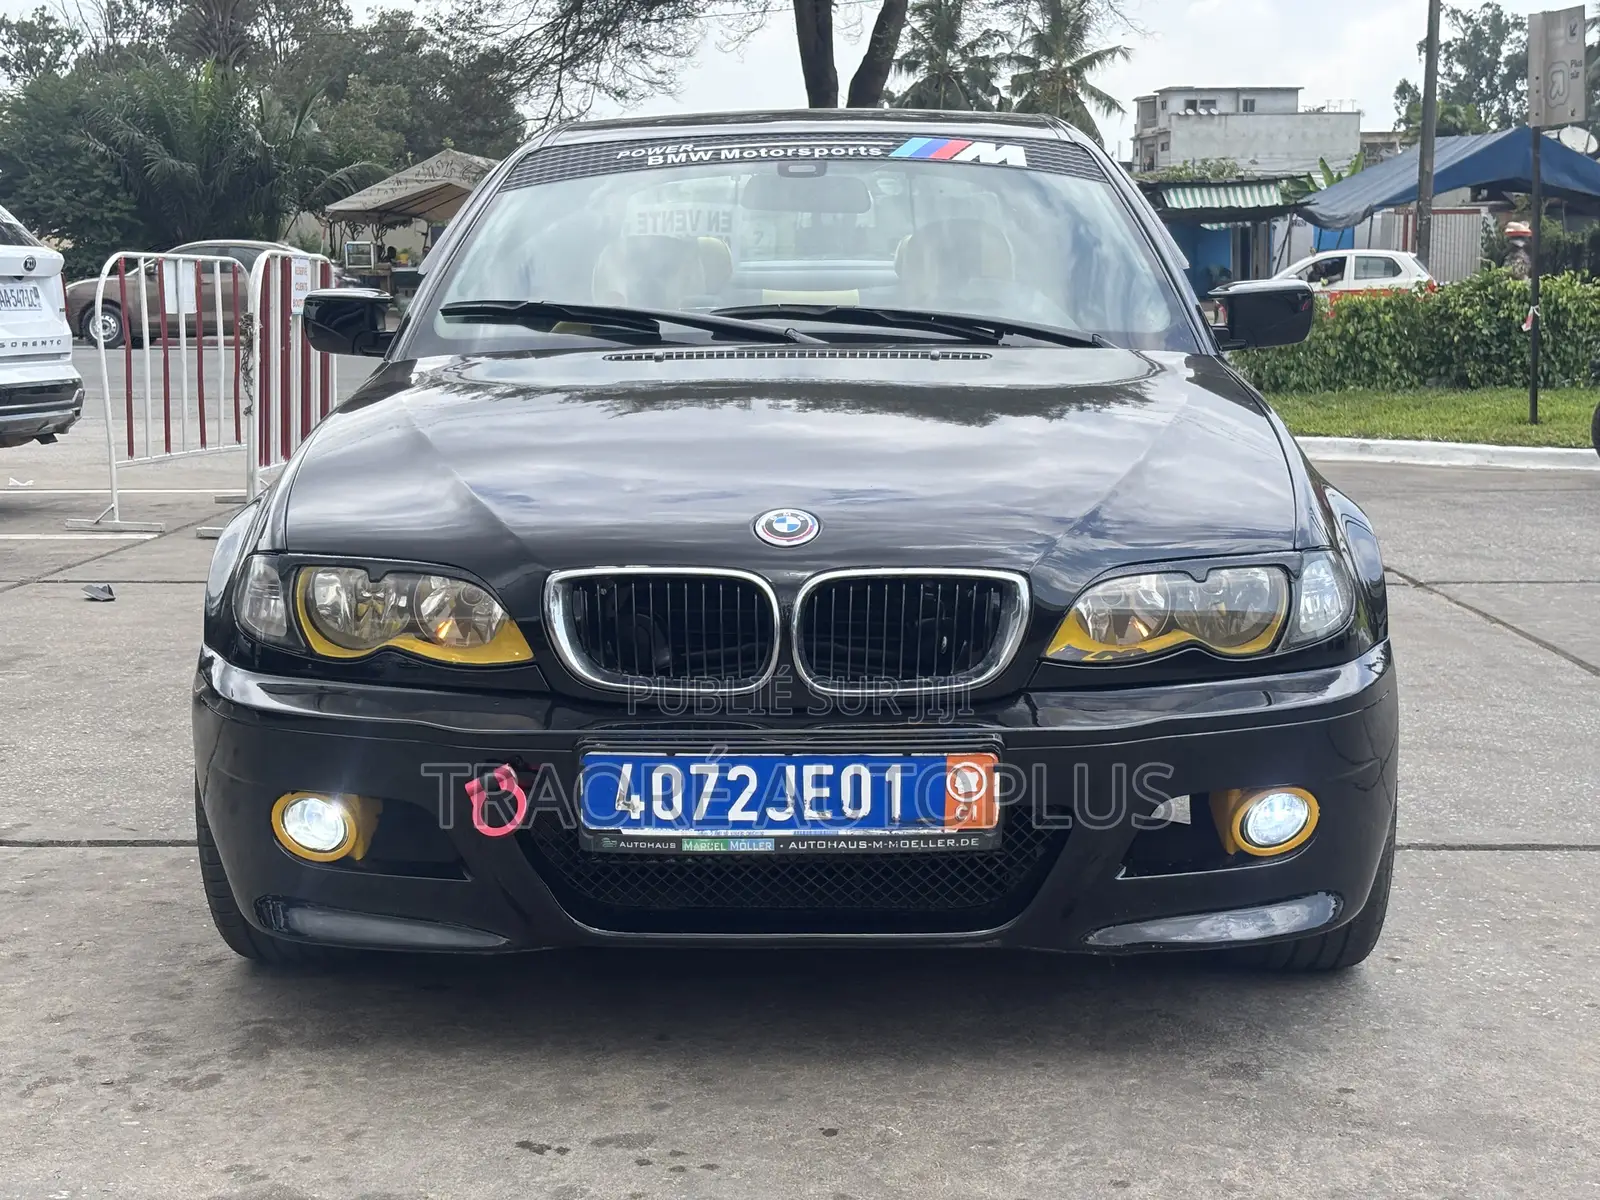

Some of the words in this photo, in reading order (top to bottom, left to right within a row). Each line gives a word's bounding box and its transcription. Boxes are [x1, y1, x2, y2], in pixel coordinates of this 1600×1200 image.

[616, 144, 694, 160] POWER
[647, 150, 713, 166] BMW
[720, 146, 883, 160] Motorsports
[0, 339, 62, 349] SORENTO
[615, 763, 901, 822] 4072JE01
[619, 841, 677, 849] AUTOHAUS
[684, 839, 726, 851] MARCEL
[788, 837, 979, 849] AUTOHAUS-M-MOELLER.DE
